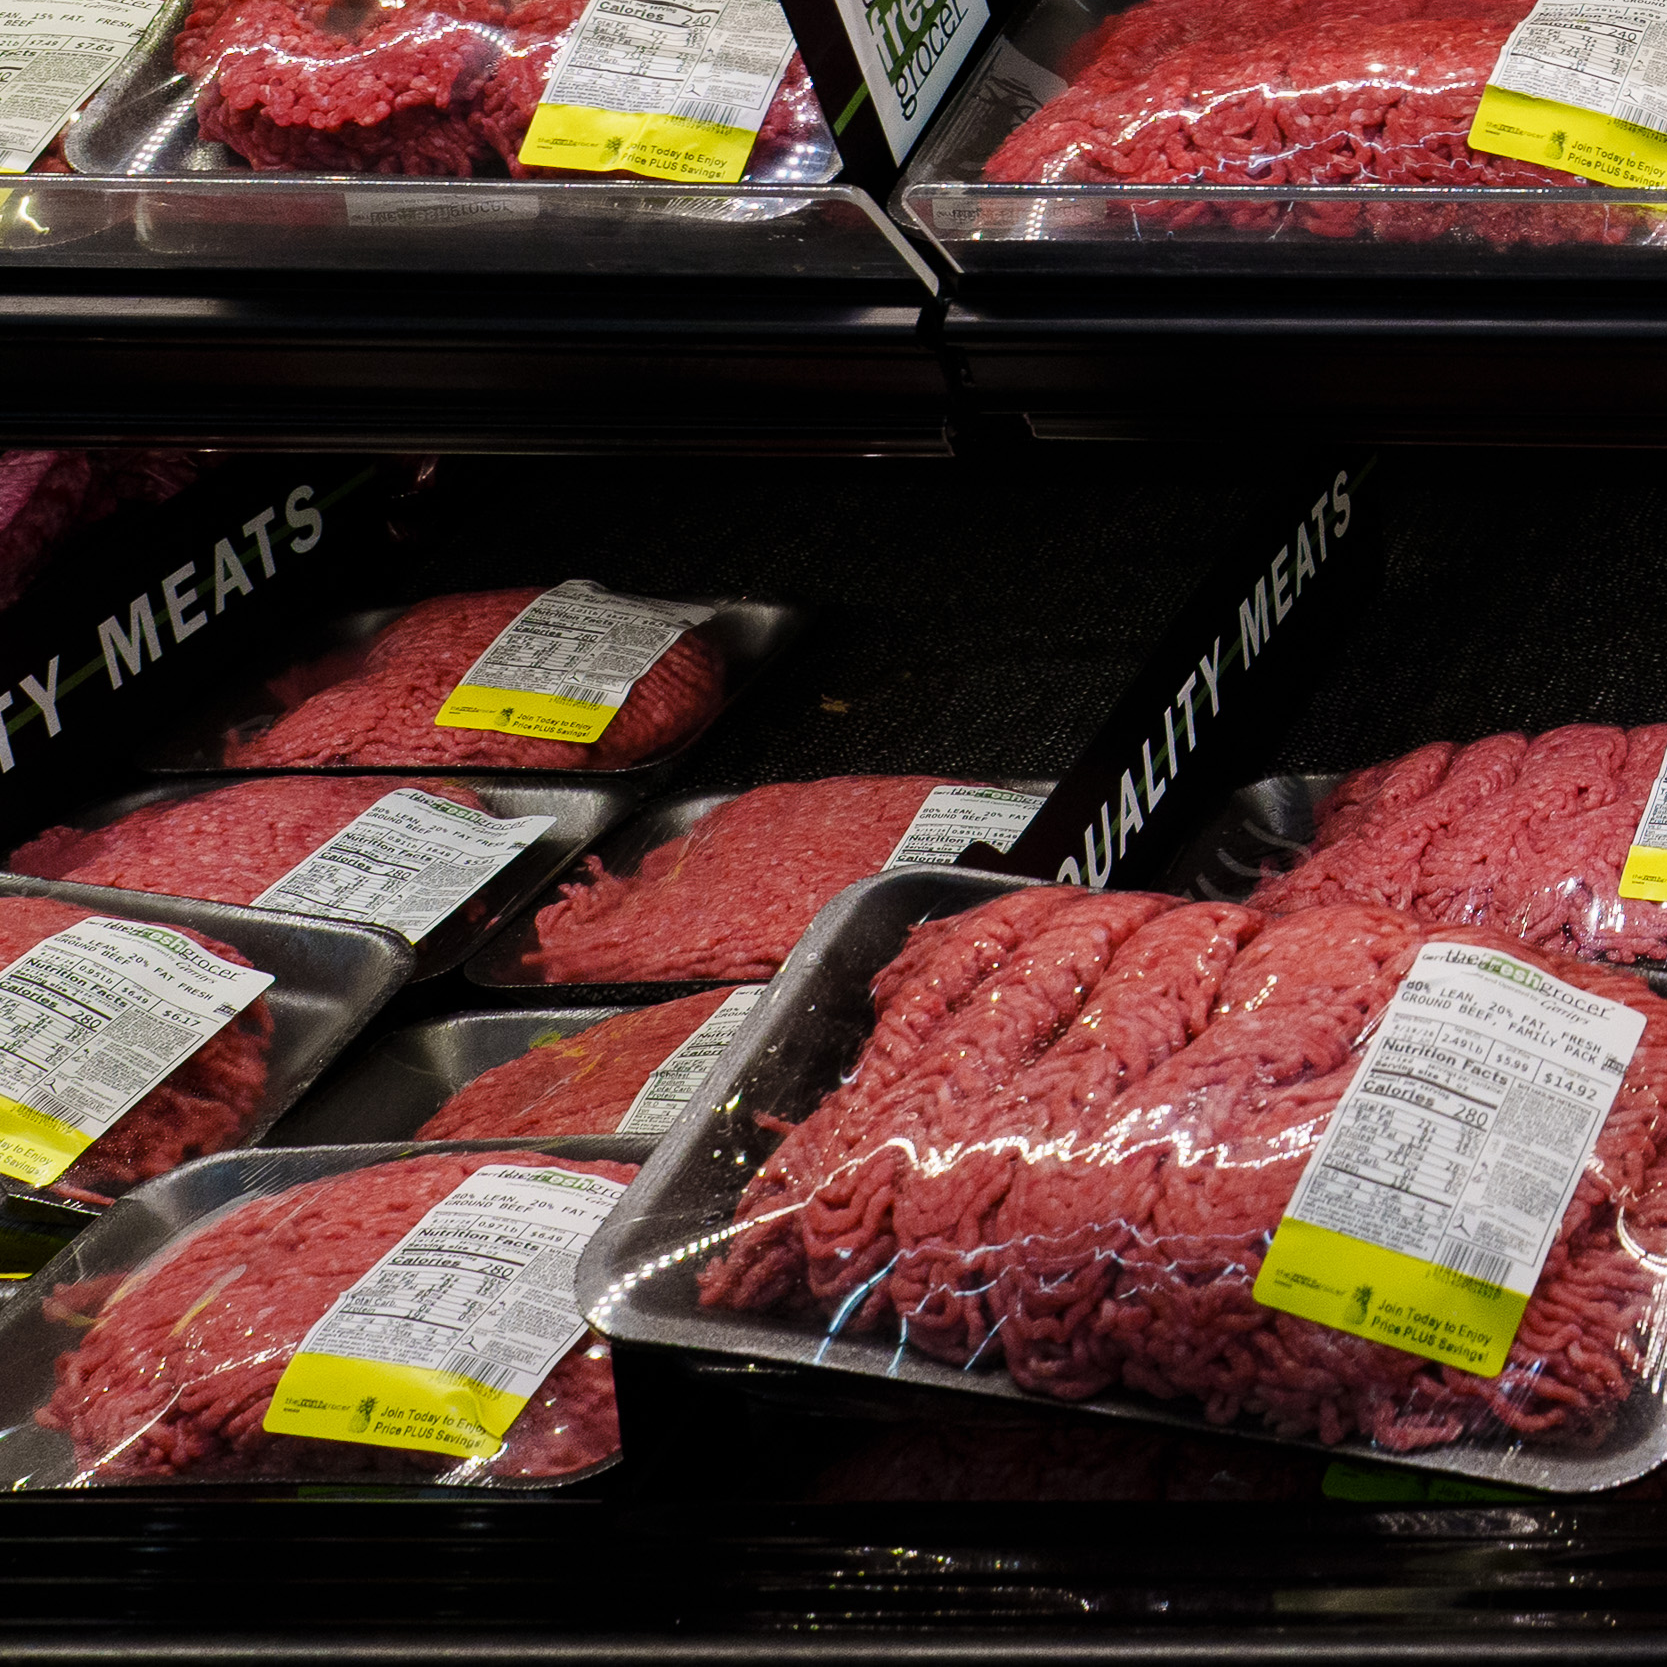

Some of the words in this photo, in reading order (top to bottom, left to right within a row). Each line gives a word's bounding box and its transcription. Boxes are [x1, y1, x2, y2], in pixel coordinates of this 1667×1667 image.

[599, 1, 665, 22] Calories
[682, 14, 711, 27] 240
[649, 157, 678, 172] PLUS
[681, 164, 726, 179] Savings!
[97, 485, 323, 690] MEATS
[1239, 470, 1351, 671] MEATS
[72, 1010, 103, 1029] 280
[1400, 992, 1452, 1012] GROUND
[1458, 1003, 1498, 1028] BEEF,
[1508, 1021, 1558, 1052] FAMILY
[1563, 1041, 1597, 1065] PACK
[1383, 1039, 1457, 1071] Nutrition
[1462, 1060, 1510, 1086] Facts
[1441, 1034, 1485, 1057] 2.49lb
[1496, 1051, 1530, 1073] $5.99
[1544, 1072, 1599, 1102] $14.92
[1362, 1078, 1436, 1108] Calories
[1453, 1102, 1490, 1127] 280
[392, 1256, 461, 1268] Calories
[479, 1262, 514, 1278] 280
[1370, 1315, 1401, 1335] Price
[1403, 1325, 1435, 1347] PLUS
[1437, 1334, 1490, 1364] Savings!
[1377, 1298, 1405, 1319] Join
[1407, 1306, 1445, 1331] Today
[1445, 1317, 1457, 1333] to
[1458, 1322, 1493, 1347] Enjoy
